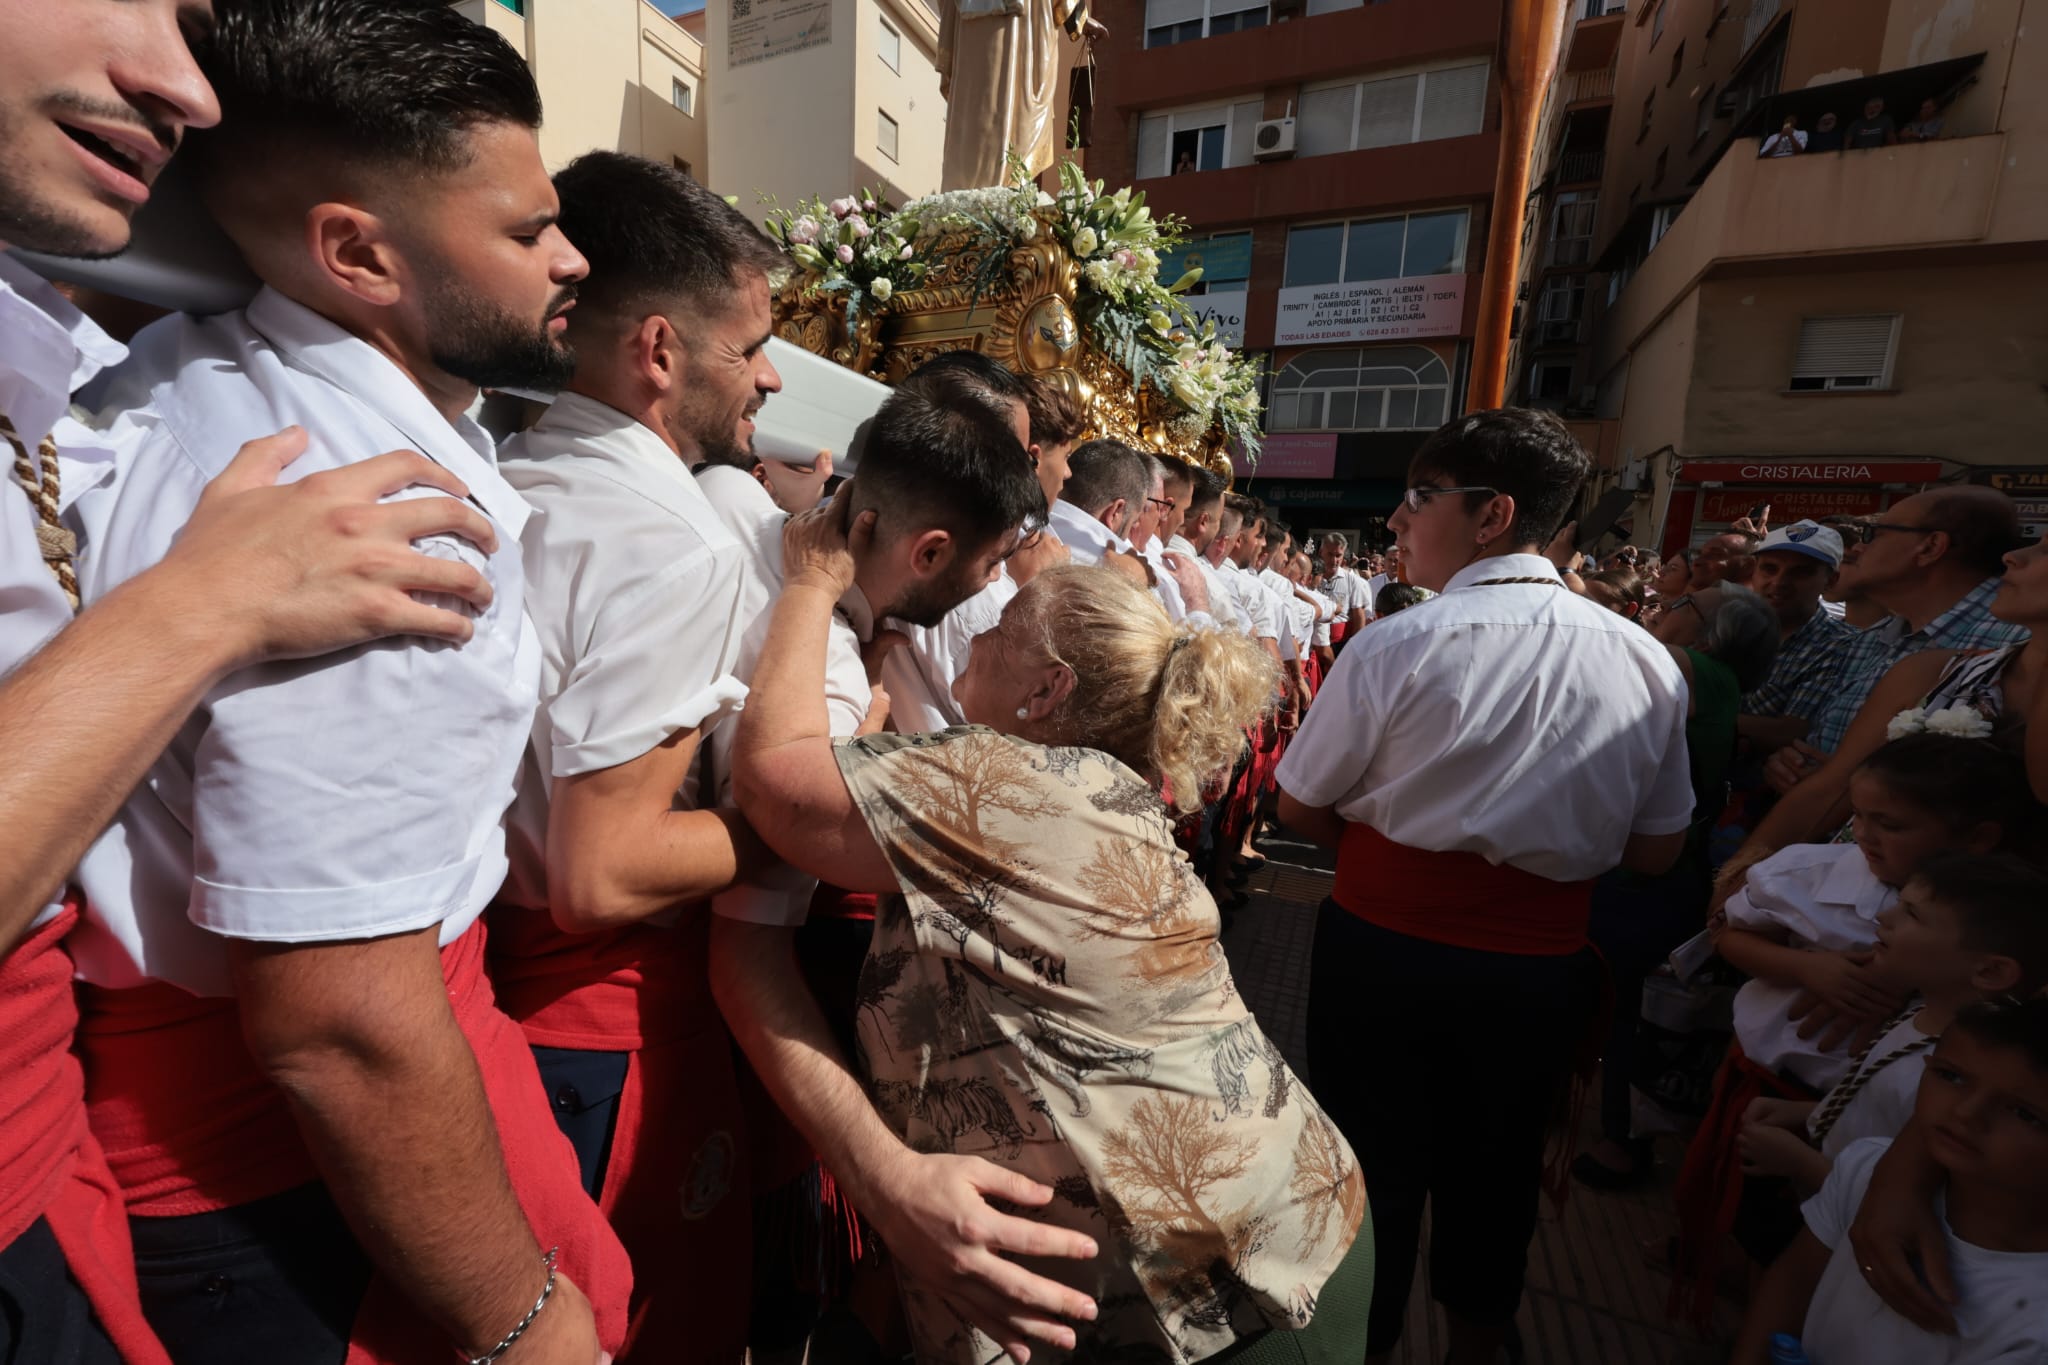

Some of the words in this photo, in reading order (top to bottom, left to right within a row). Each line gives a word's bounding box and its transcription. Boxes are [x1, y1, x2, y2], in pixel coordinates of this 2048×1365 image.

[1349, 288, 1383, 298] ESPAÑOL
[1283, 303, 1309, 311] TRINITY
[1318, 300, 1361, 309] CAMBRIDGE
[1371, 296, 1392, 304] APTIS
[1402, 294, 1422, 302] IELTS
[1307, 319, 1333, 327] APOYO
[1334, 317, 1369, 325] PRIMARIA
[1377, 313, 1426, 322] SECUNDARIA
[1321, 330, 1351, 338] EDADES
[1740, 465, 1872, 479] CRISTALERIA
[1288, 487, 1345, 501] cajamar
[1774, 492, 1872, 505] CRISTALERIA
